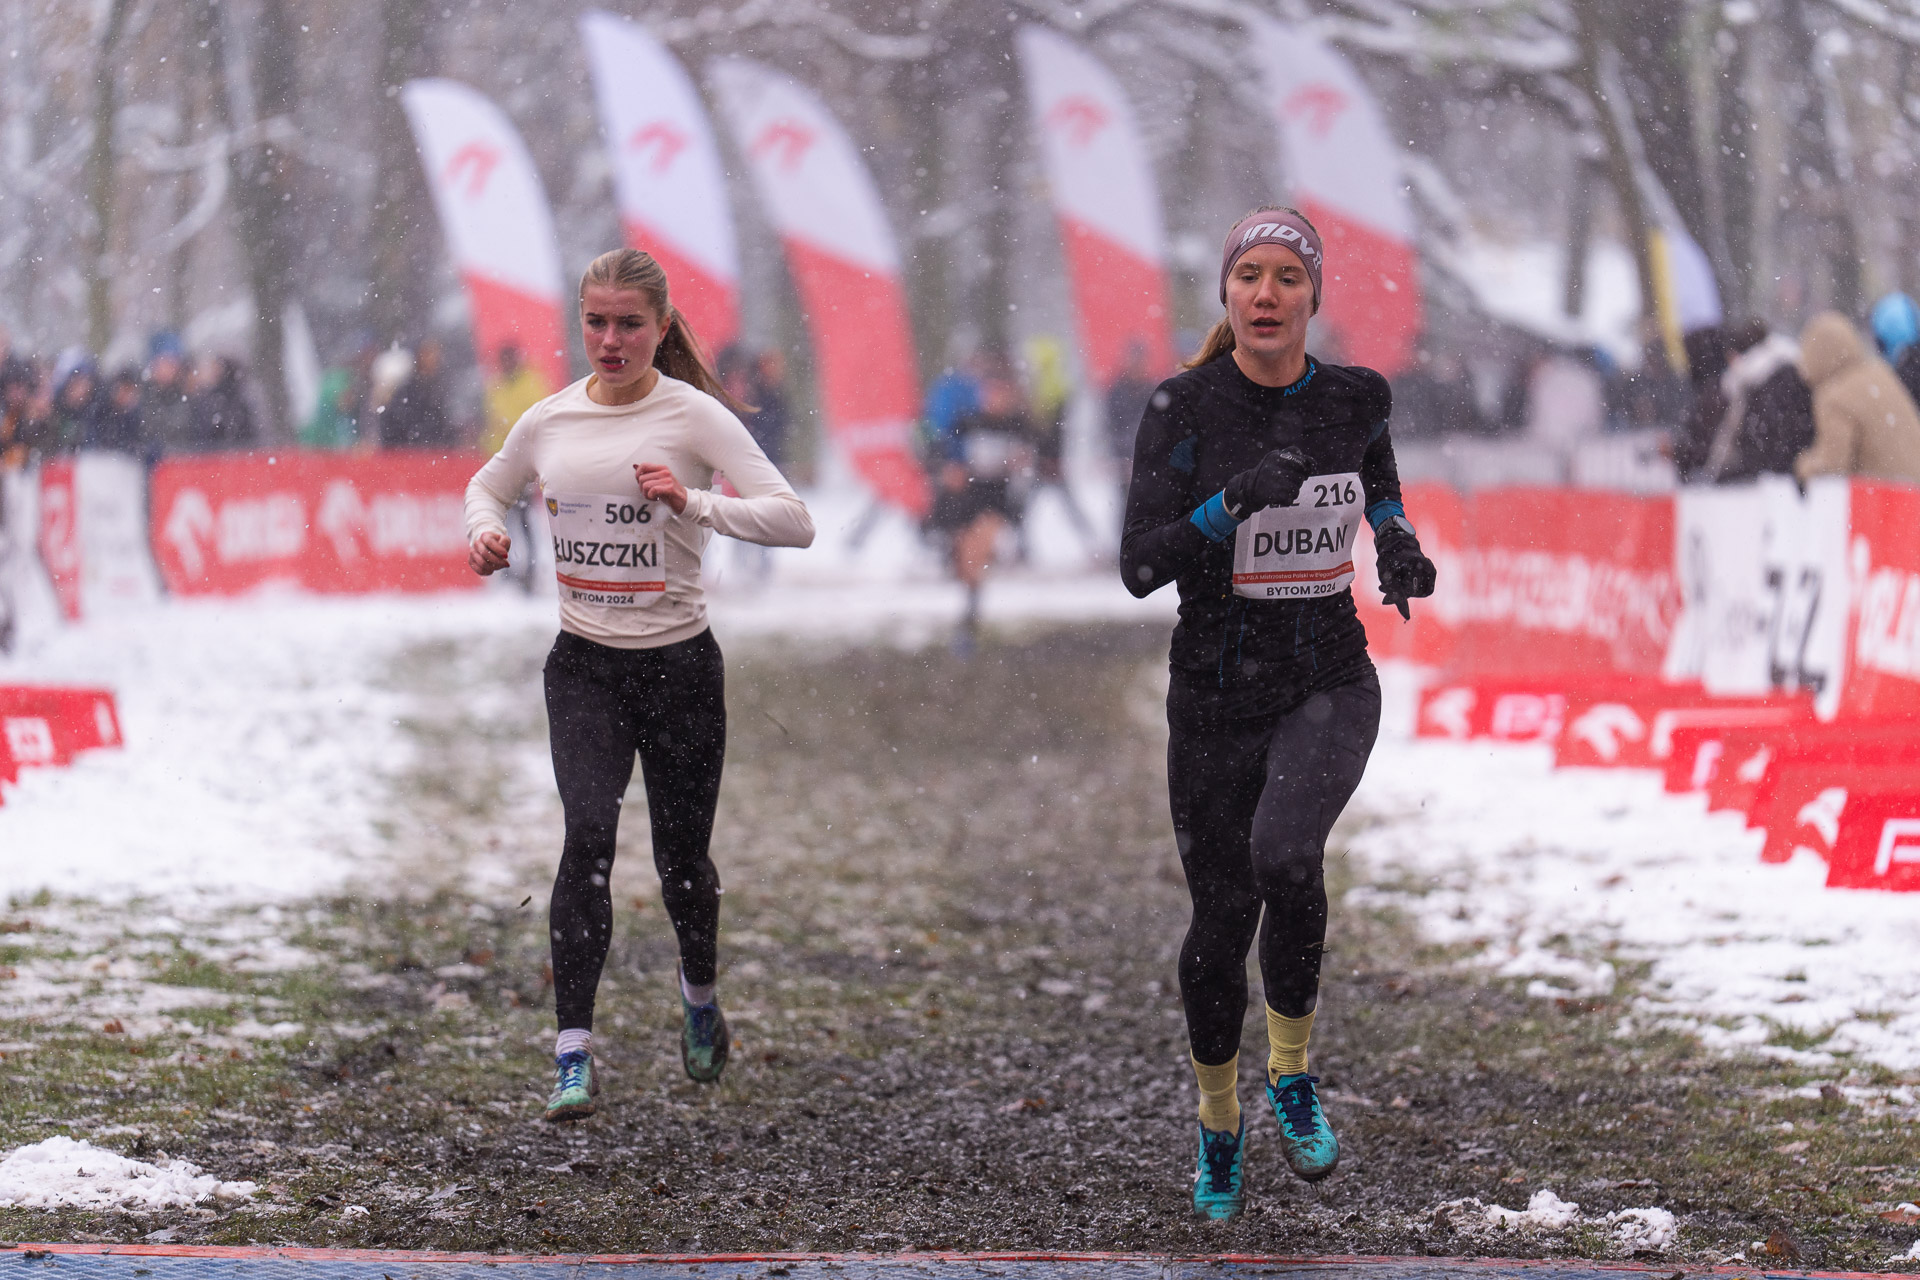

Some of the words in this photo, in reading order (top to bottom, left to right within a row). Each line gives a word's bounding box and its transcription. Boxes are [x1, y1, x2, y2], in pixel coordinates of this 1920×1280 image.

[1283, 362, 1316, 397] ALPINUS
[1313, 481, 1357, 508] 216
[605, 503, 652, 524] 506
[554, 535, 657, 567] ŁUSZCZKI
[1253, 524, 1348, 557] DUBAN
[571, 590, 605, 603] BYTOM
[606, 595, 635, 604] 2024
[1266, 585, 1311, 596] BYTOM
[1313, 582, 1336, 594] 2024
